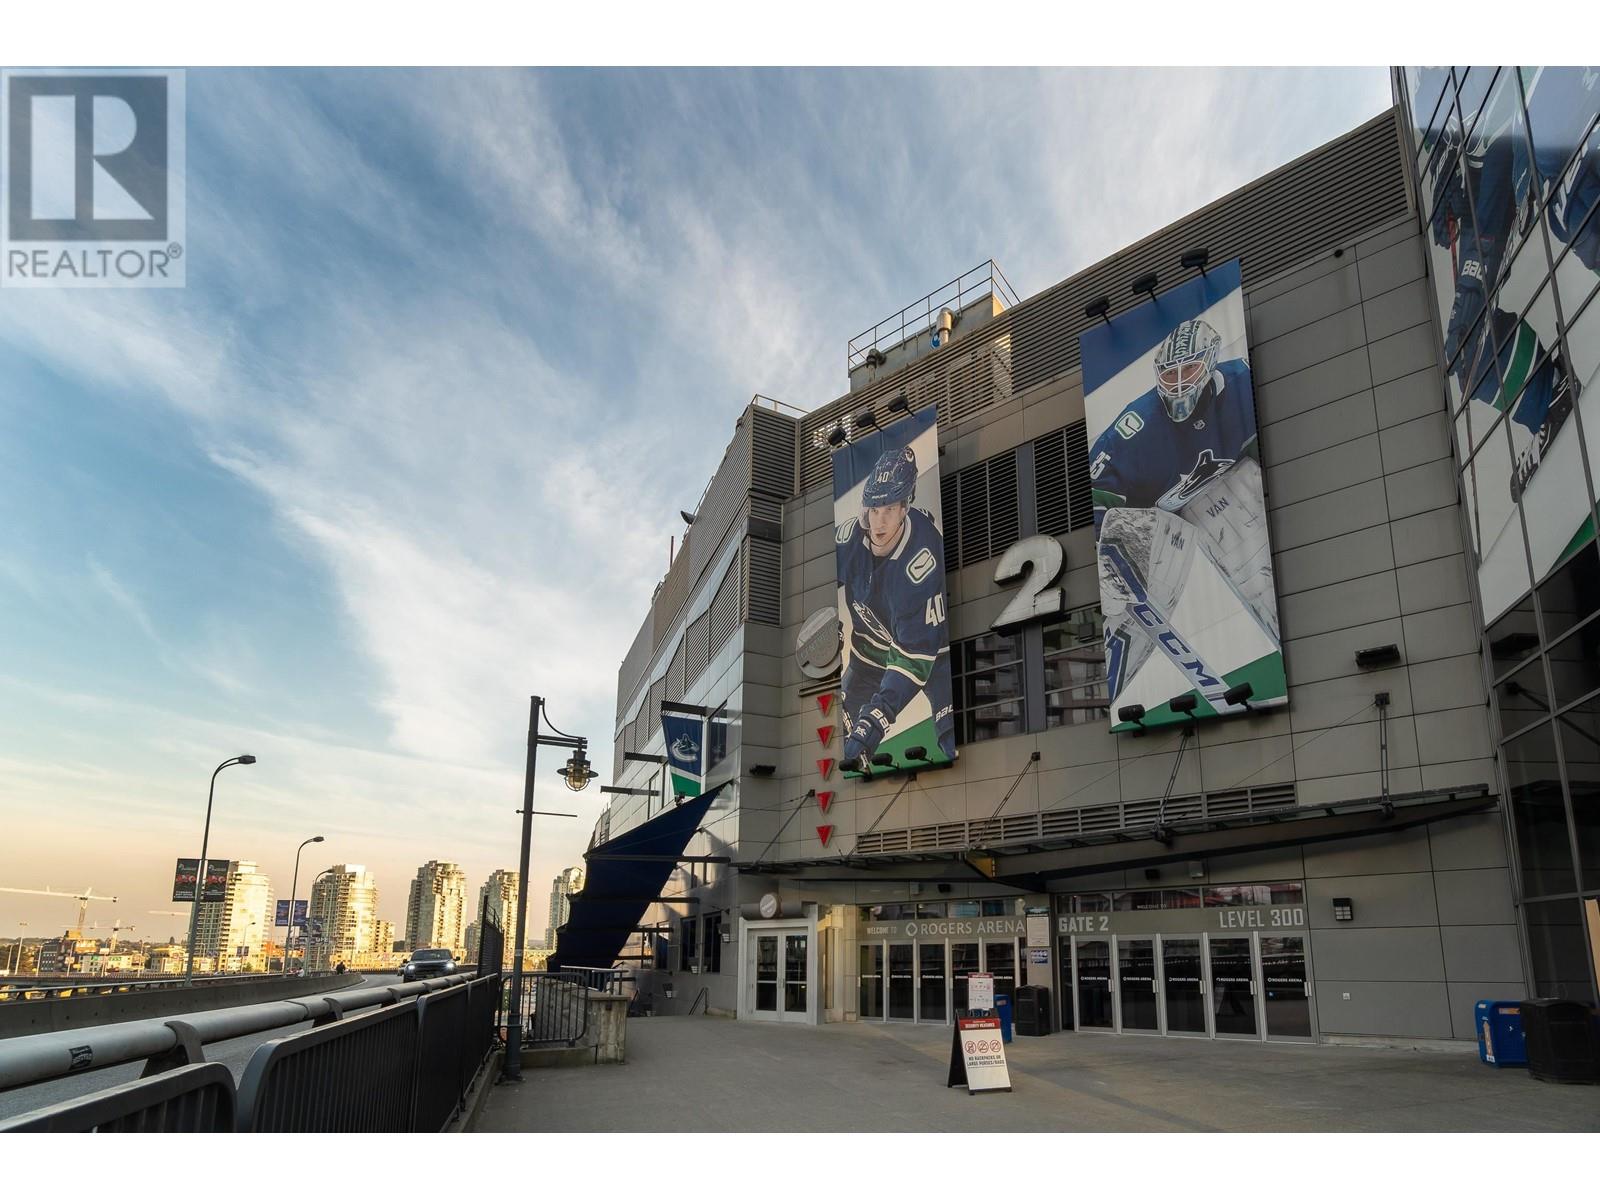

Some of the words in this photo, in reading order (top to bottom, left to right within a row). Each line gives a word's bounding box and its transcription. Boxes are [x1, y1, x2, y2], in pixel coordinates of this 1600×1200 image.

[876, 471, 890, 484] 40
[1206, 496, 1230, 518] VAN
[989, 533, 1065, 630] 2
[925, 592, 946, 627] 40
[1132, 603, 1221, 688] CCM
[920, 921, 972, 936] ROGERS
[976, 920, 1025, 934] ARENA
[1058, 916, 1094, 933] GATE
[1099, 915, 1109, 932] 2
[1219, 911, 1265, 929] LEVEL
[1271, 908, 1305, 927] 300
